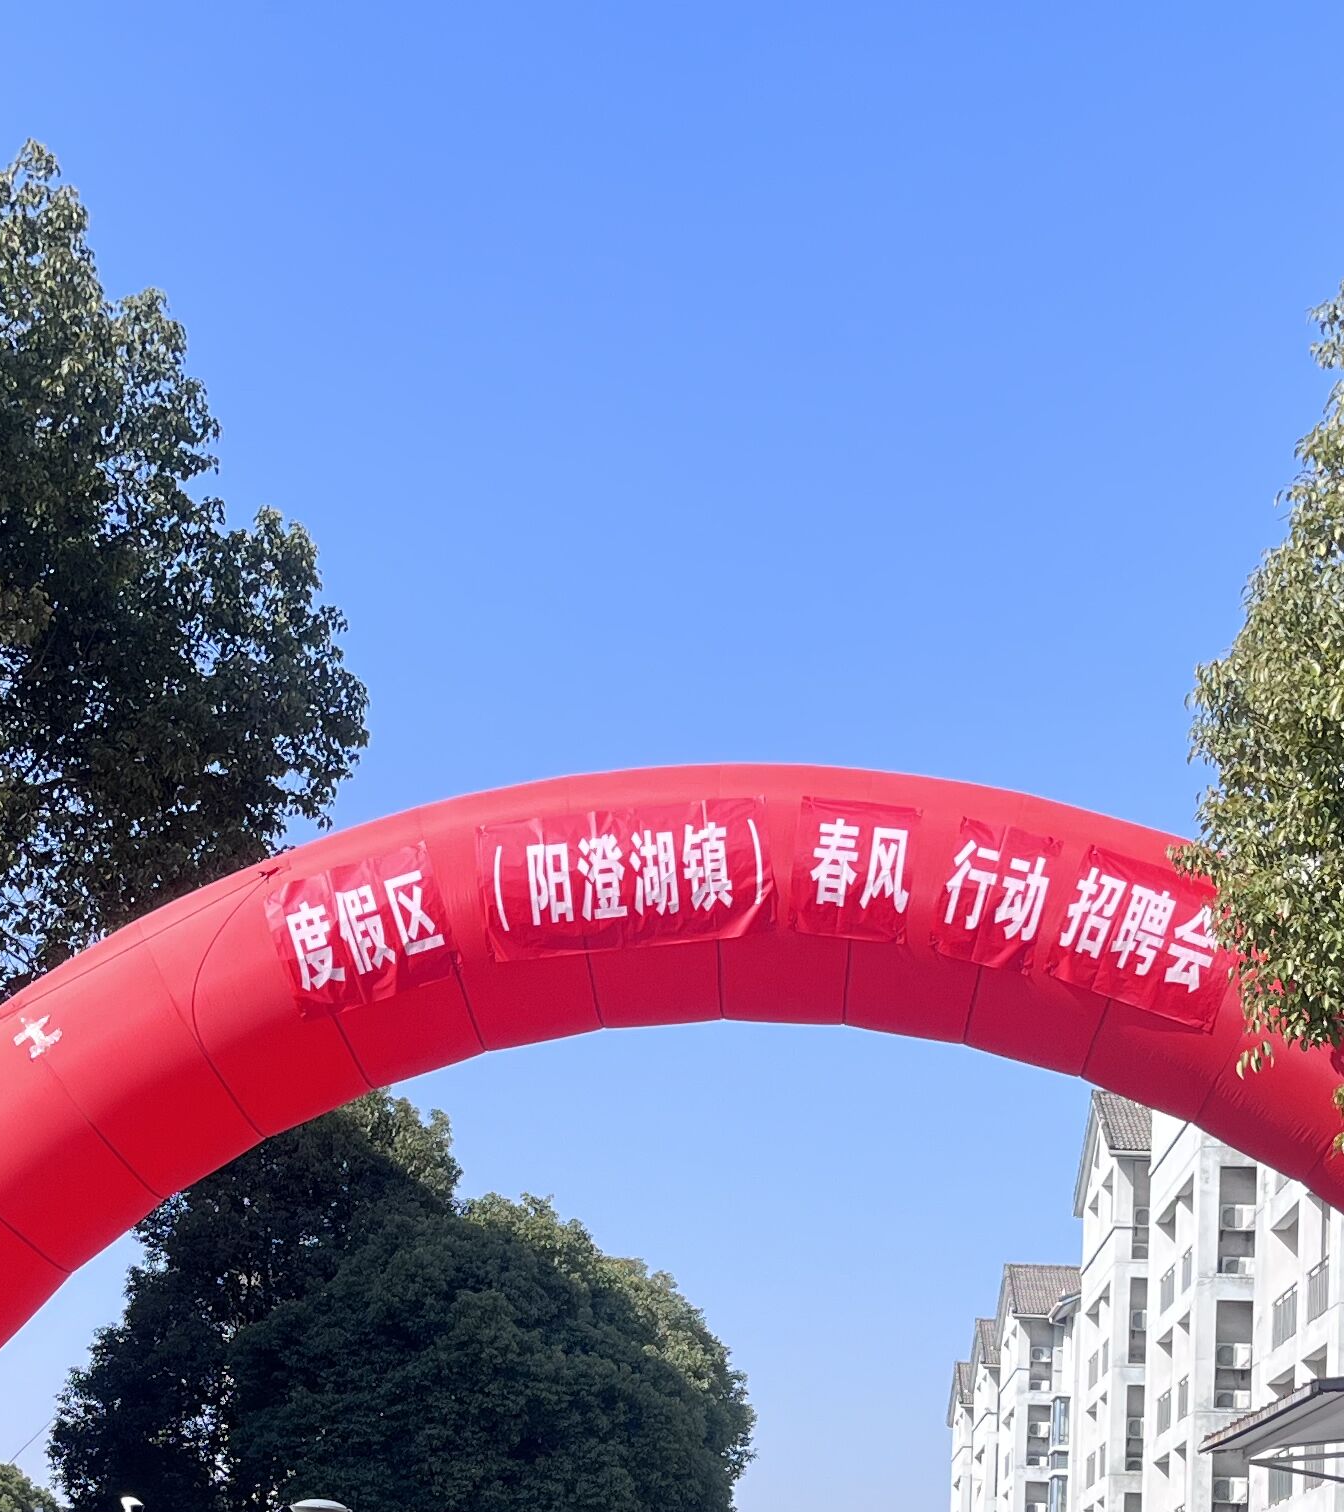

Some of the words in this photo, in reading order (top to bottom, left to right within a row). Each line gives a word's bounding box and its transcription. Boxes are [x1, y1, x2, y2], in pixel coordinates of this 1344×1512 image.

[286, 869, 445, 992] 度假区
[810, 817, 909, 915] 春风
[945, 839, 1050, 942] 行动
[1058, 866, 1217, 993] 招聘会
